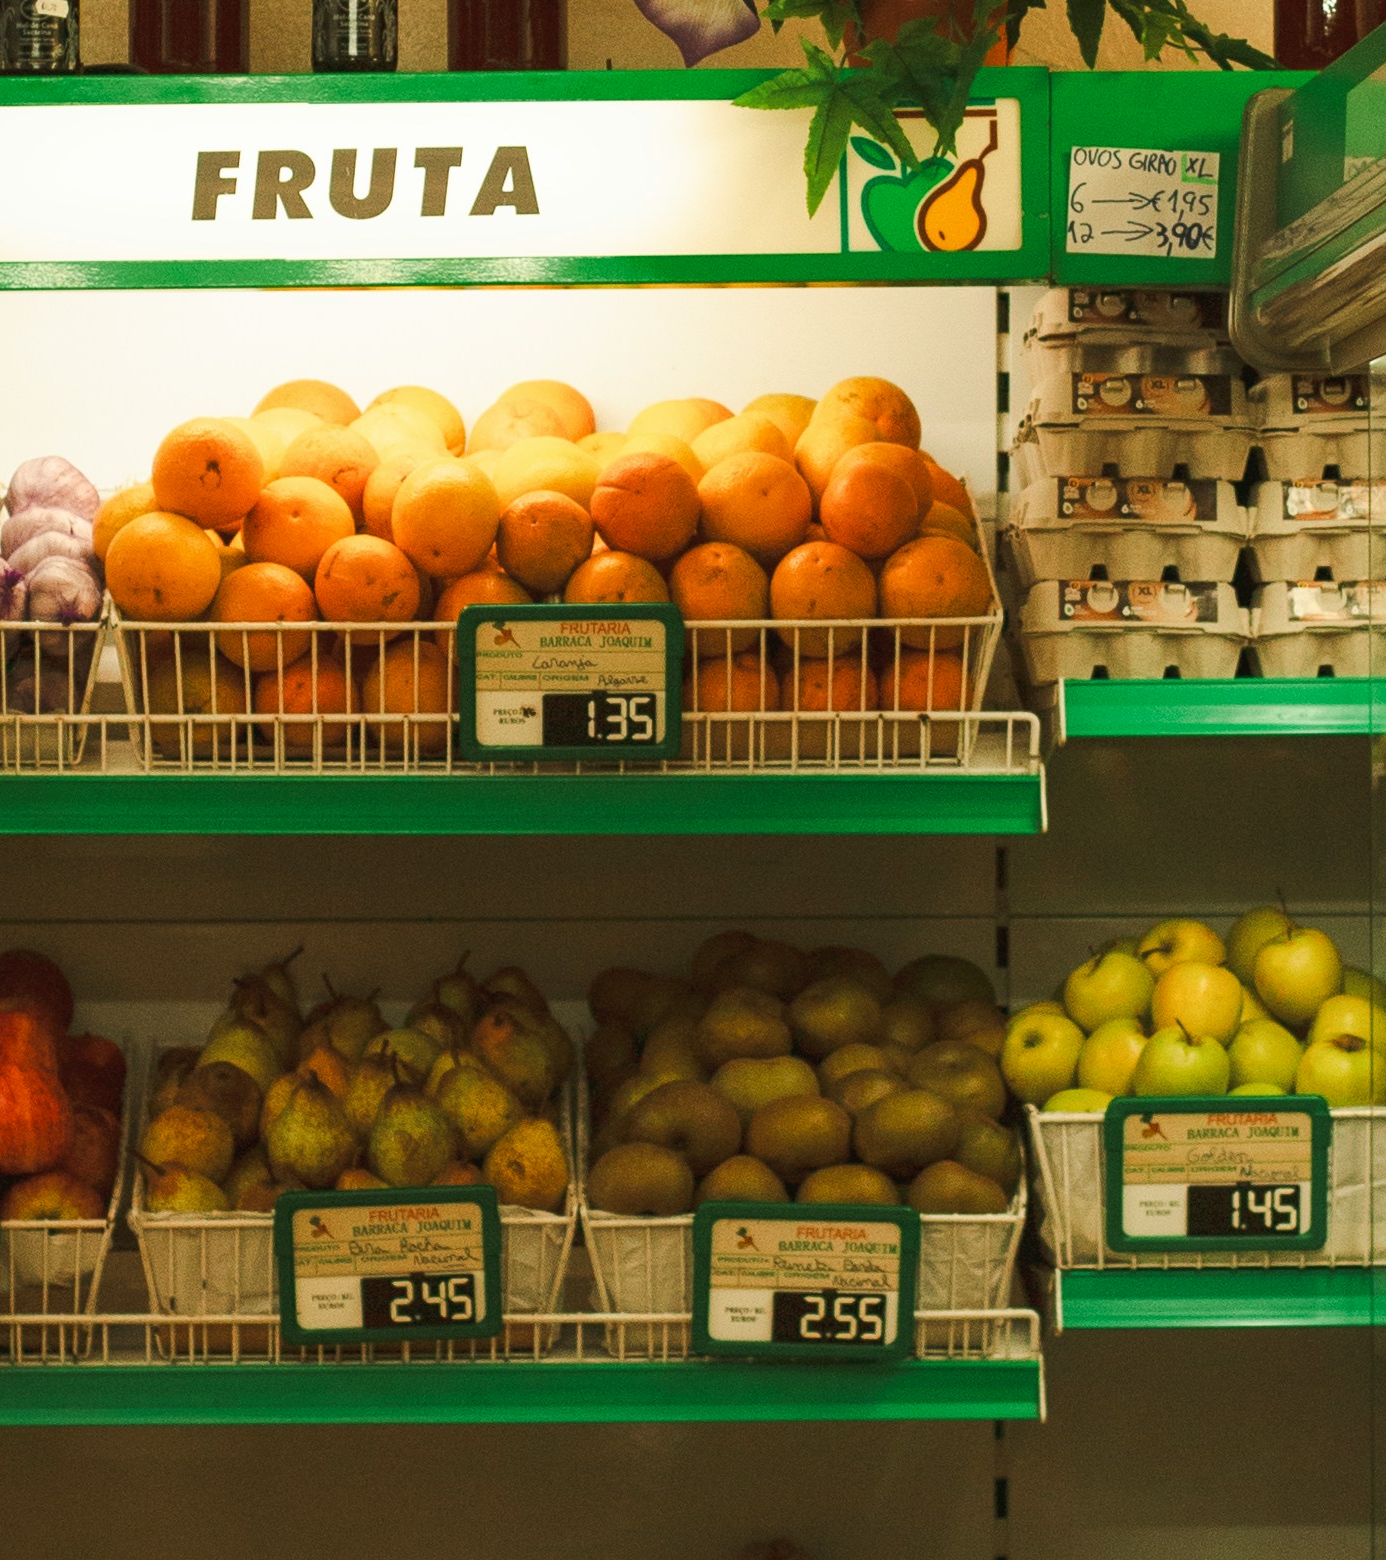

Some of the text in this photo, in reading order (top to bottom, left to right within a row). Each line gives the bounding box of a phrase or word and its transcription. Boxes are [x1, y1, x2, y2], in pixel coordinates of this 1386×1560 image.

[1073, 147, 1122, 169] OVOS
[1185, 157, 1214, 177] XL
[191, 145, 541, 222] FRUTA
[1070, 182, 1087, 213] 6
[1067, 220, 1094, 244] 12
[560, 622, 632, 635] FRUTARIA
[540, 636, 654, 648] BARRACA JOAQUIM
[532, 655, 600, 674] Laranja
[587, 696, 654, 742] 1.35
[1187, 1126, 1300, 1140] BARRACA JOAQUIM
[368, 1208, 441, 1223] FRUTARIA
[1232, 1187, 1298, 1231] 1.45
[352, 1219, 472, 1237] BARRACA JOAQUIM
[795, 1226, 868, 1240] FRUTARIA
[778, 1241, 899, 1255] BARRACA JOAQUIM
[390, 1277, 473, 1323] 2.45
[800, 1296, 883, 1340] 2.55
